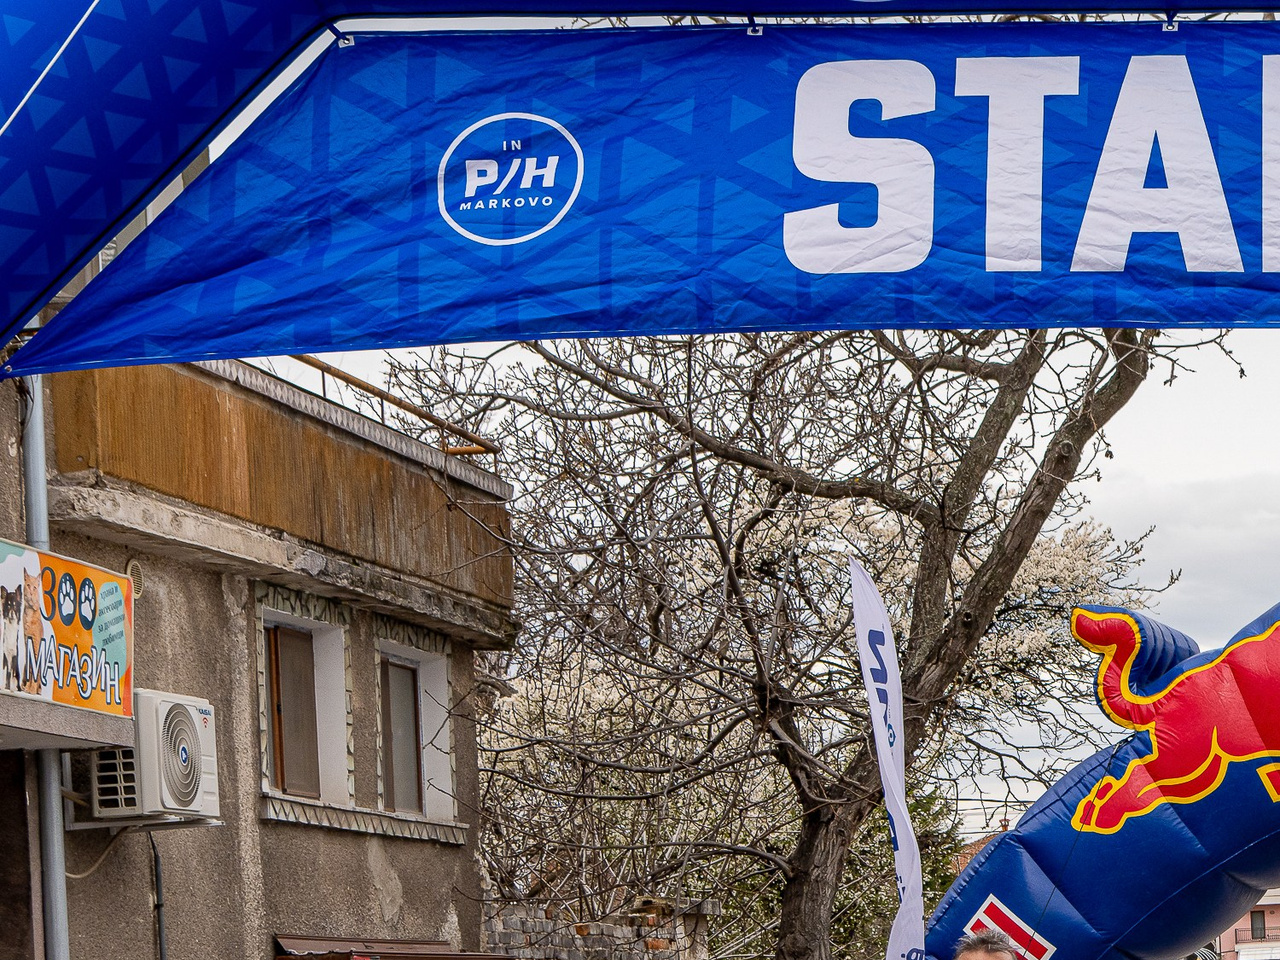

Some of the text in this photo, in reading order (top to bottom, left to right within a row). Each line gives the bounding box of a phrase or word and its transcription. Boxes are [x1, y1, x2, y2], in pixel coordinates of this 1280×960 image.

[502, 140, 522, 151] IN
[464, 155, 560, 198] P/H
[459, 196, 553, 211] MARKOVO
[26, 634, 122, 706] МАГАЗИН
